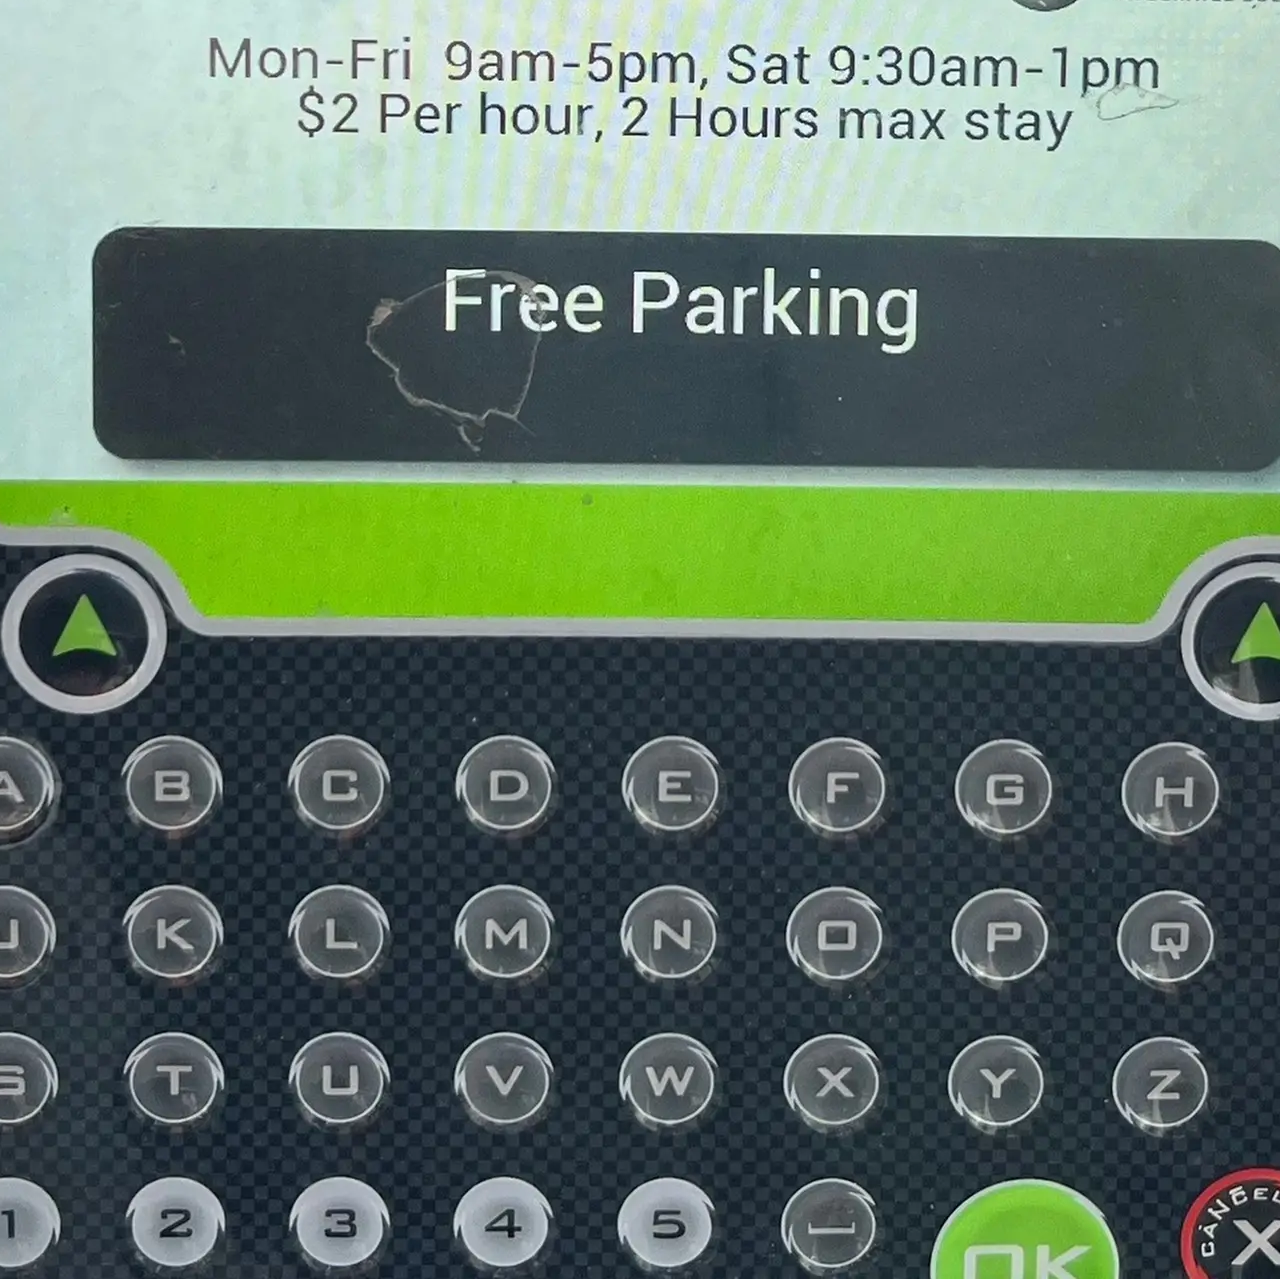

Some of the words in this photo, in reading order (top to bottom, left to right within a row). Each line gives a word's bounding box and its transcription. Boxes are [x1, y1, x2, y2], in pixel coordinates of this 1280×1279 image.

[209, 37, 413, 80] Mon-Fri
[445, 41, 708, 92] 9am-5pm,
[727, 44, 811, 86] Sat
[829, 45, 1160, 98] 9:30am-1pm
[298, 86, 359, 138] $2
[379, 93, 462, 135] Per
[480, 92, 605, 142] hour,
[622, 97, 650, 137] 2
[669, 97, 819, 139] Hours
[839, 107, 947, 140] max
[964, 105, 1073, 151] stay
[445, 267, 604, 333] Free
[632, 267, 920, 355] Parking
[153, 769, 190, 802] B
[322, 769, 358, 802] C
[489, 770, 529, 802] D
[657, 770, 692, 804] E
[825, 771, 860, 804] F
[985, 773, 1024, 806] G
[1154, 775, 1194, 807] H
[156, 918, 193, 950] K
[325, 918, 357, 949] L
[484, 918, 527, 949] M
[652, 919, 691, 950] N
[817, 919, 857, 950] O
[986, 921, 1022, 952] P
[1149, 921, 1190, 961] Q
[155, 1064, 192, 1096] T
[322, 1065, 358, 1096] U
[484, 1065, 524, 1096] V
[643, 1065, 694, 1096] W
[815, 1067, 854, 1098] X
[979, 1067, 1016, 1098] Y
[1147, 1069, 1180, 1100] Z
[0, 1208, 16, 1239] 1
[158, 1207, 193, 1239] 2
[324, 1207, 357, 1238] 3
[483, 1207, 522, 1239] 4
[651, 1207, 686, 1238] 5
